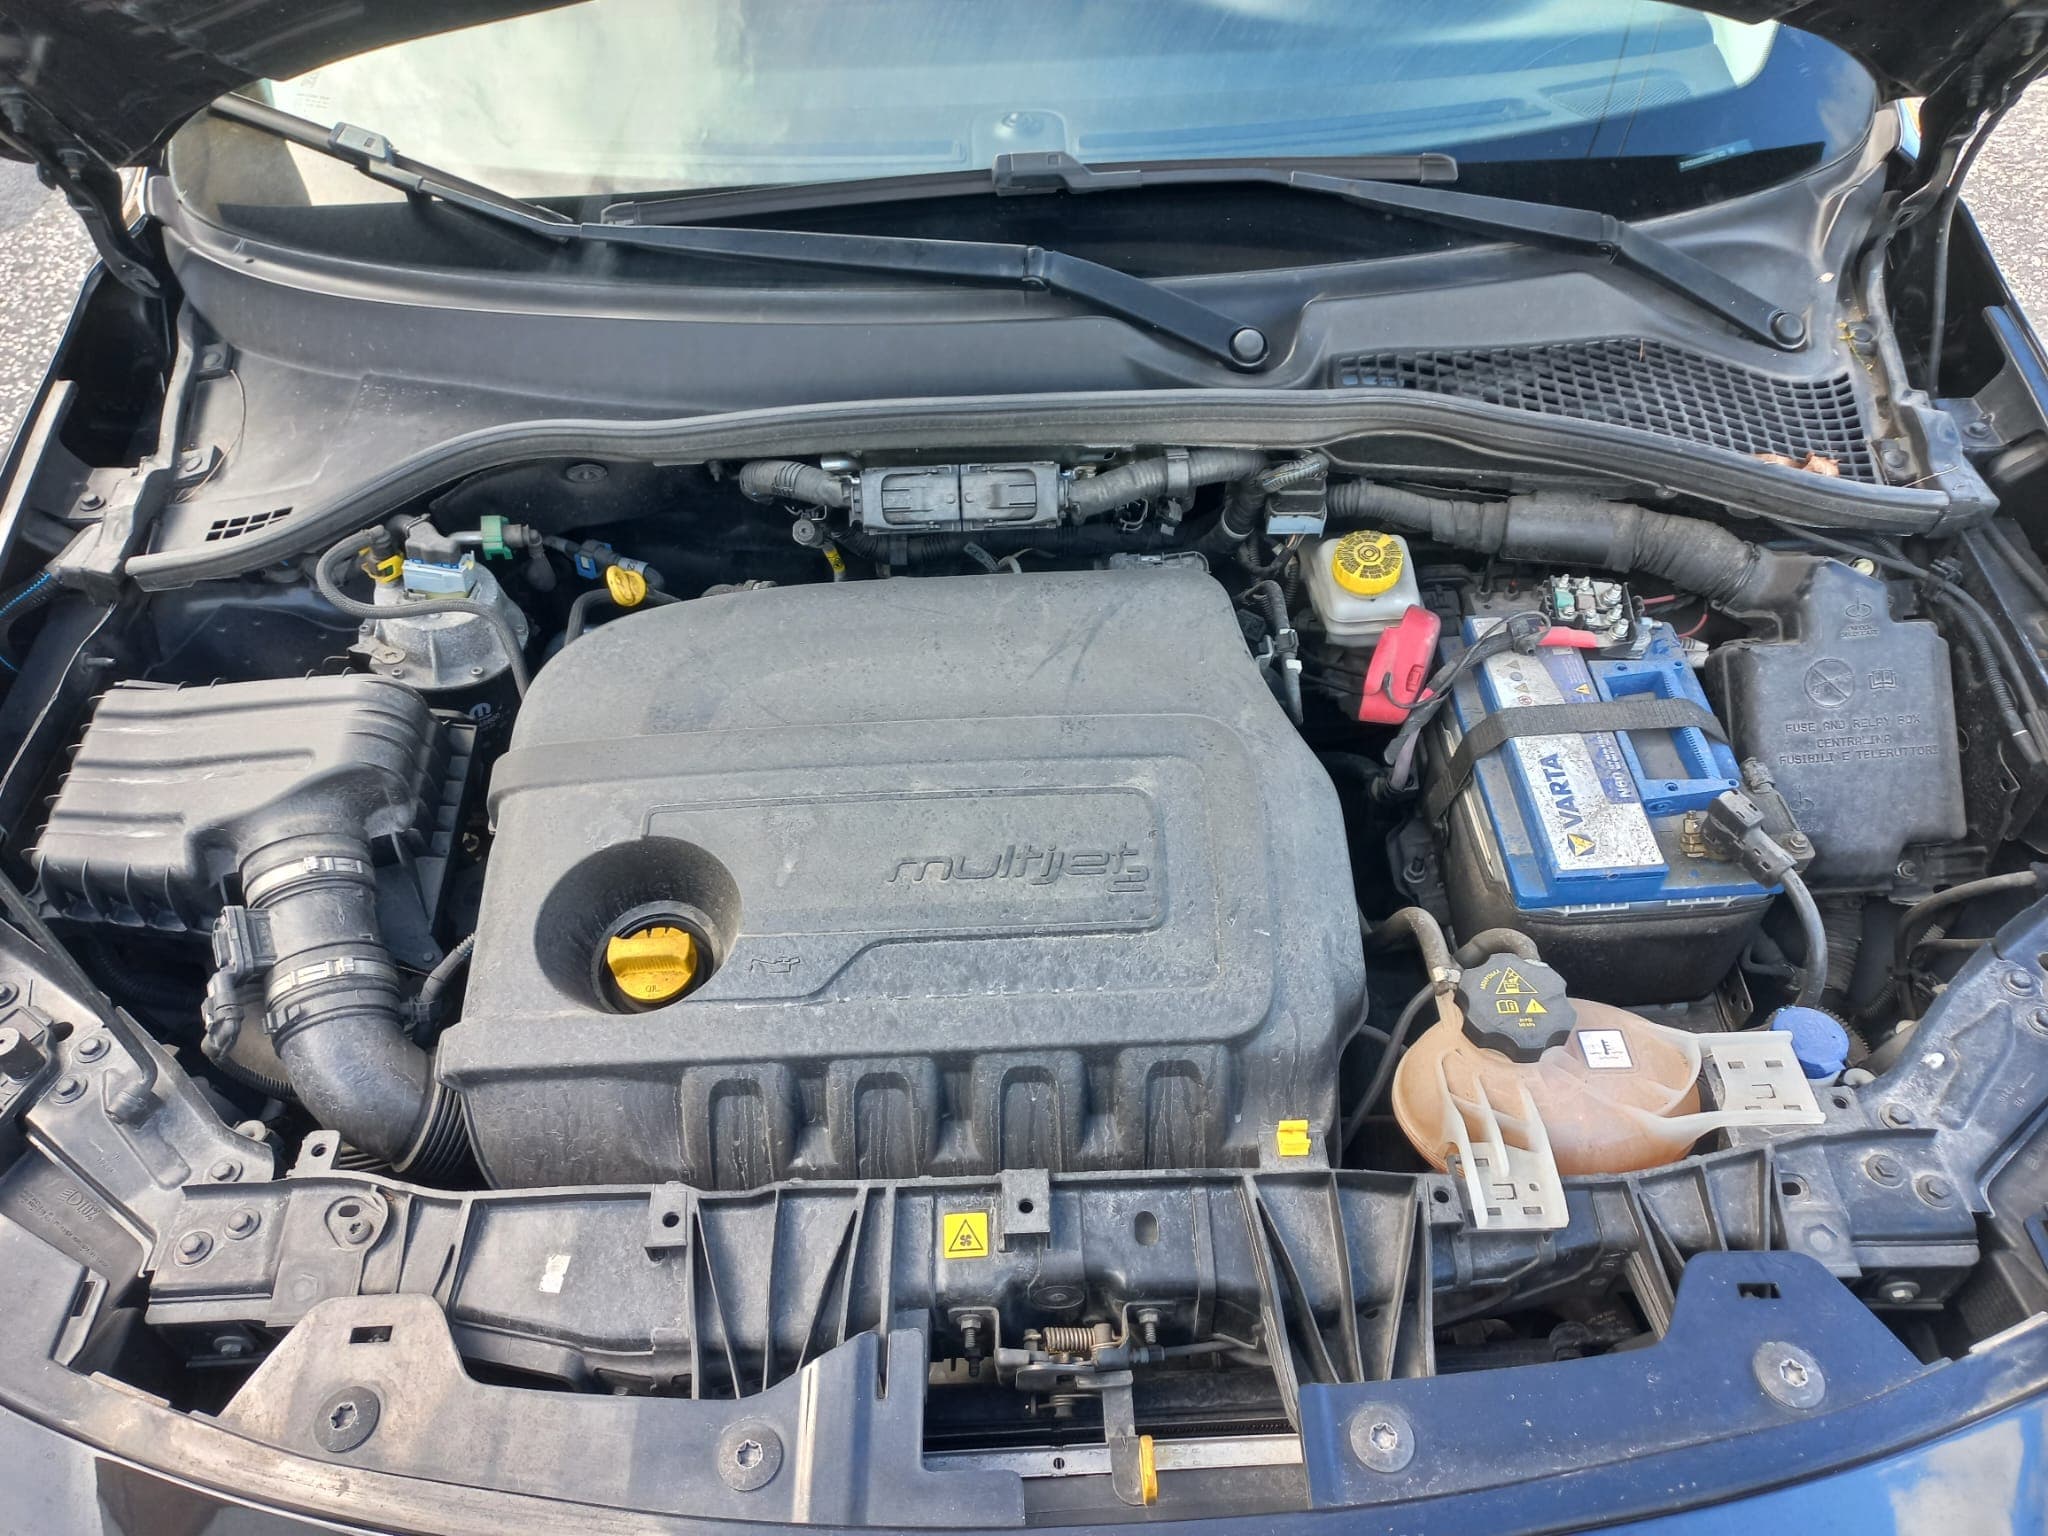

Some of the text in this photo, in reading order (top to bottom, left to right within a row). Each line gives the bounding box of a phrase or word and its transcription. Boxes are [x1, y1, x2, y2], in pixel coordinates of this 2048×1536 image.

[1785, 714, 1921, 734] FUSE AND RELAY BOX
[1816, 734, 1893, 748] CENTRALINA
[1780, 752, 1834, 765] FUSIBILI
[1842, 751, 1851, 761] E
[1540, 754, 1583, 829] VARTA
